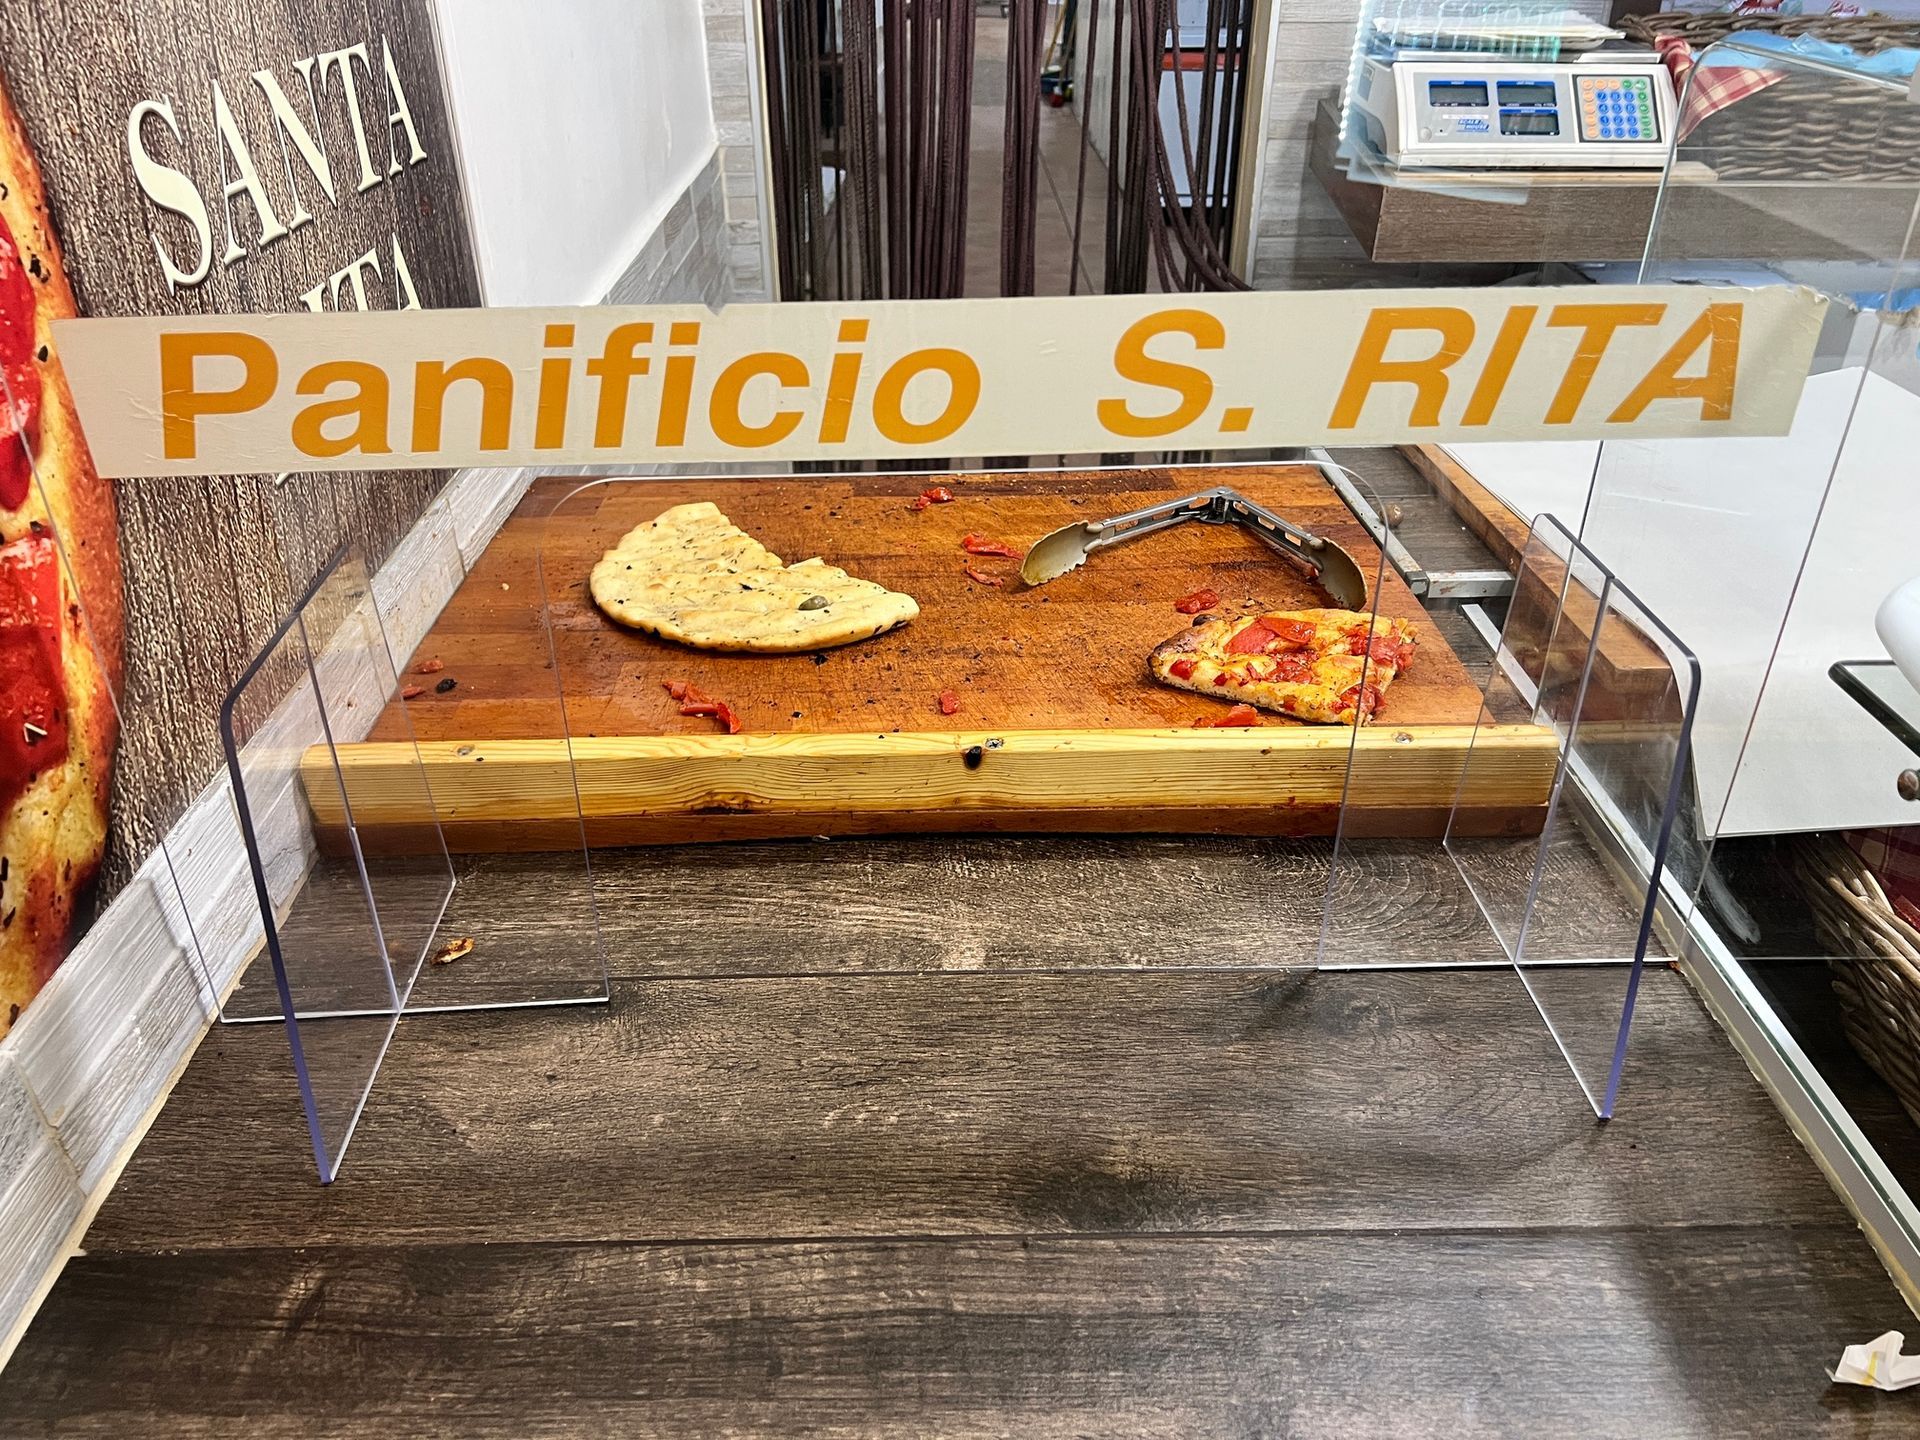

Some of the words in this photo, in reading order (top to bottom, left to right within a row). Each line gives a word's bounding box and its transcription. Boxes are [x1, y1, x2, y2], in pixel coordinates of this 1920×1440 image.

[127, 33, 428, 297] SANTA
[159, 319, 981, 460] Panificio
[1097, 309, 1254, 437] S.
[1328, 303, 1744, 430] RITA
